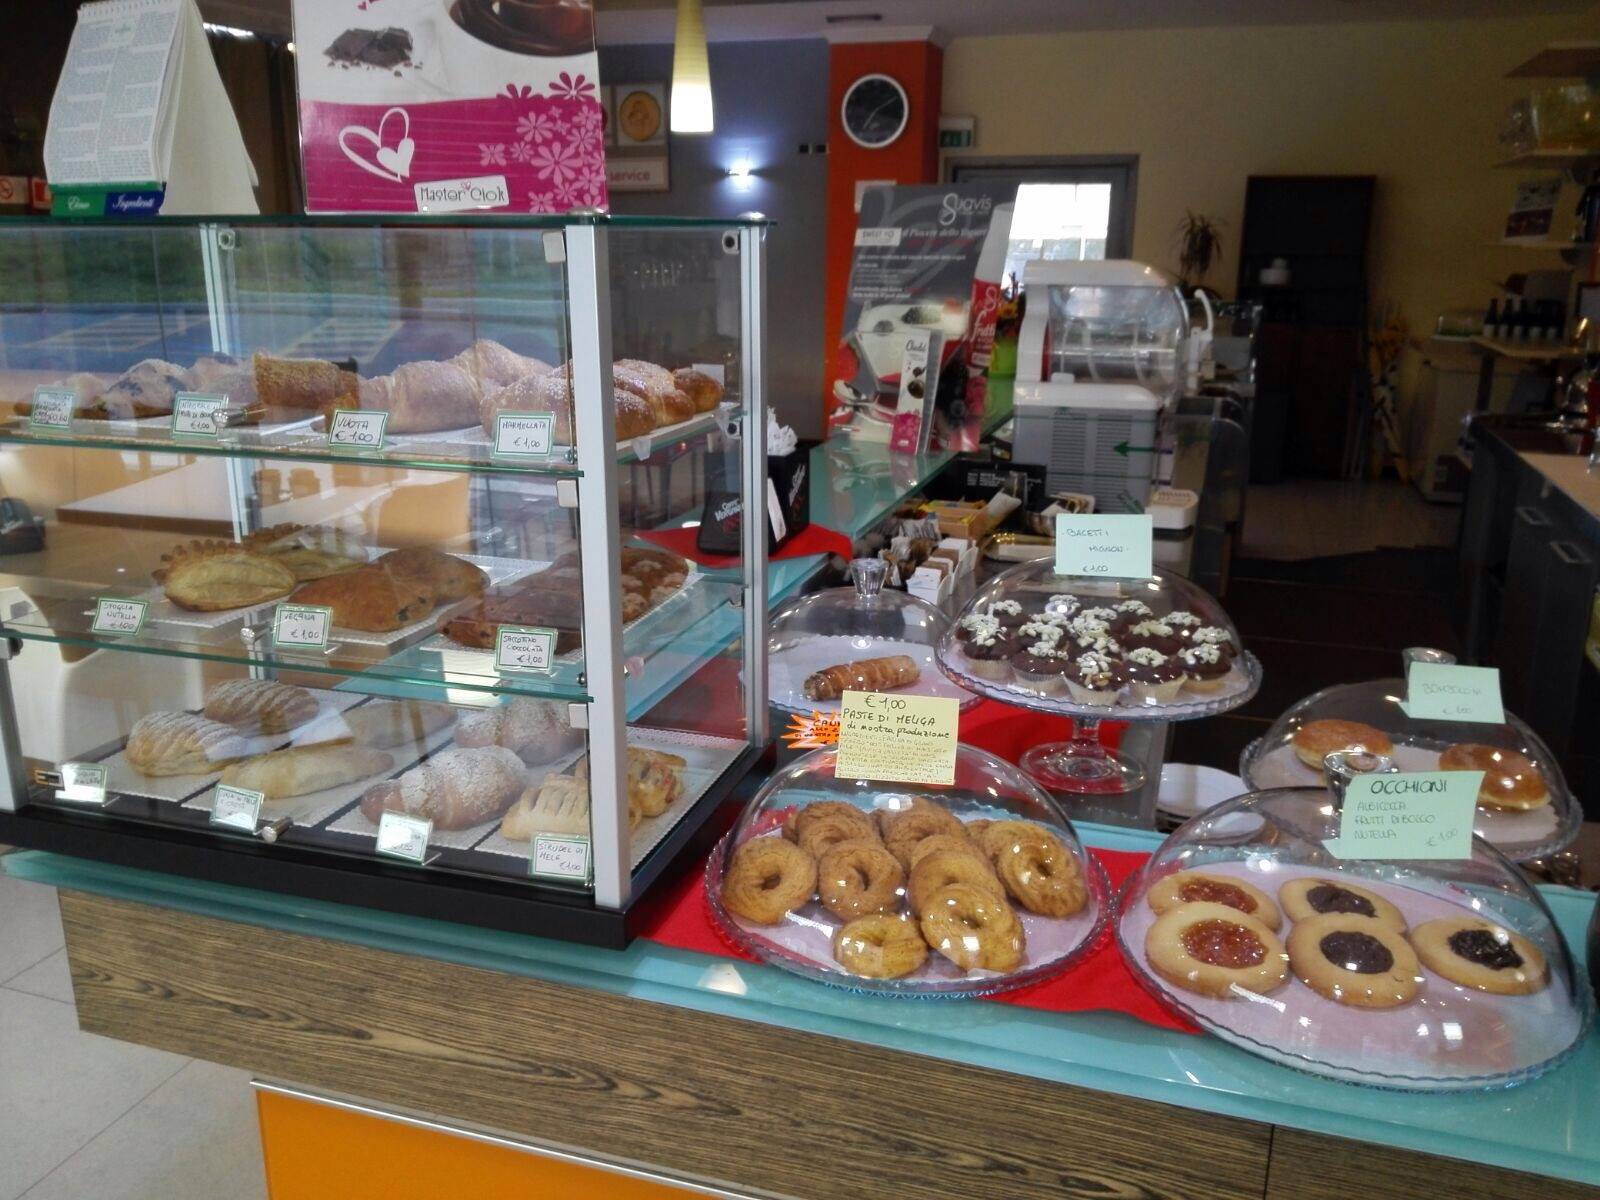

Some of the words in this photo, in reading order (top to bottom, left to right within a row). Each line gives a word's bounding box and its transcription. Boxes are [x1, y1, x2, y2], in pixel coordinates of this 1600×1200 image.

[938, 192, 992, 226] Suavis
[338, 417, 369, 431] VUOTA
[864, 694, 876, 708] €
[880, 697, 906, 713] 1,00
[842, 707, 874, 721] PASTE
[879, 714, 889, 722] DI
[896, 714, 936, 727] MELIGA
[847, 720, 856, 730] di
[1370, 779, 1447, 795] OCCHIONI
[1354, 829, 1397, 840] NUTELLA
[539, 851, 561, 861] MELE
